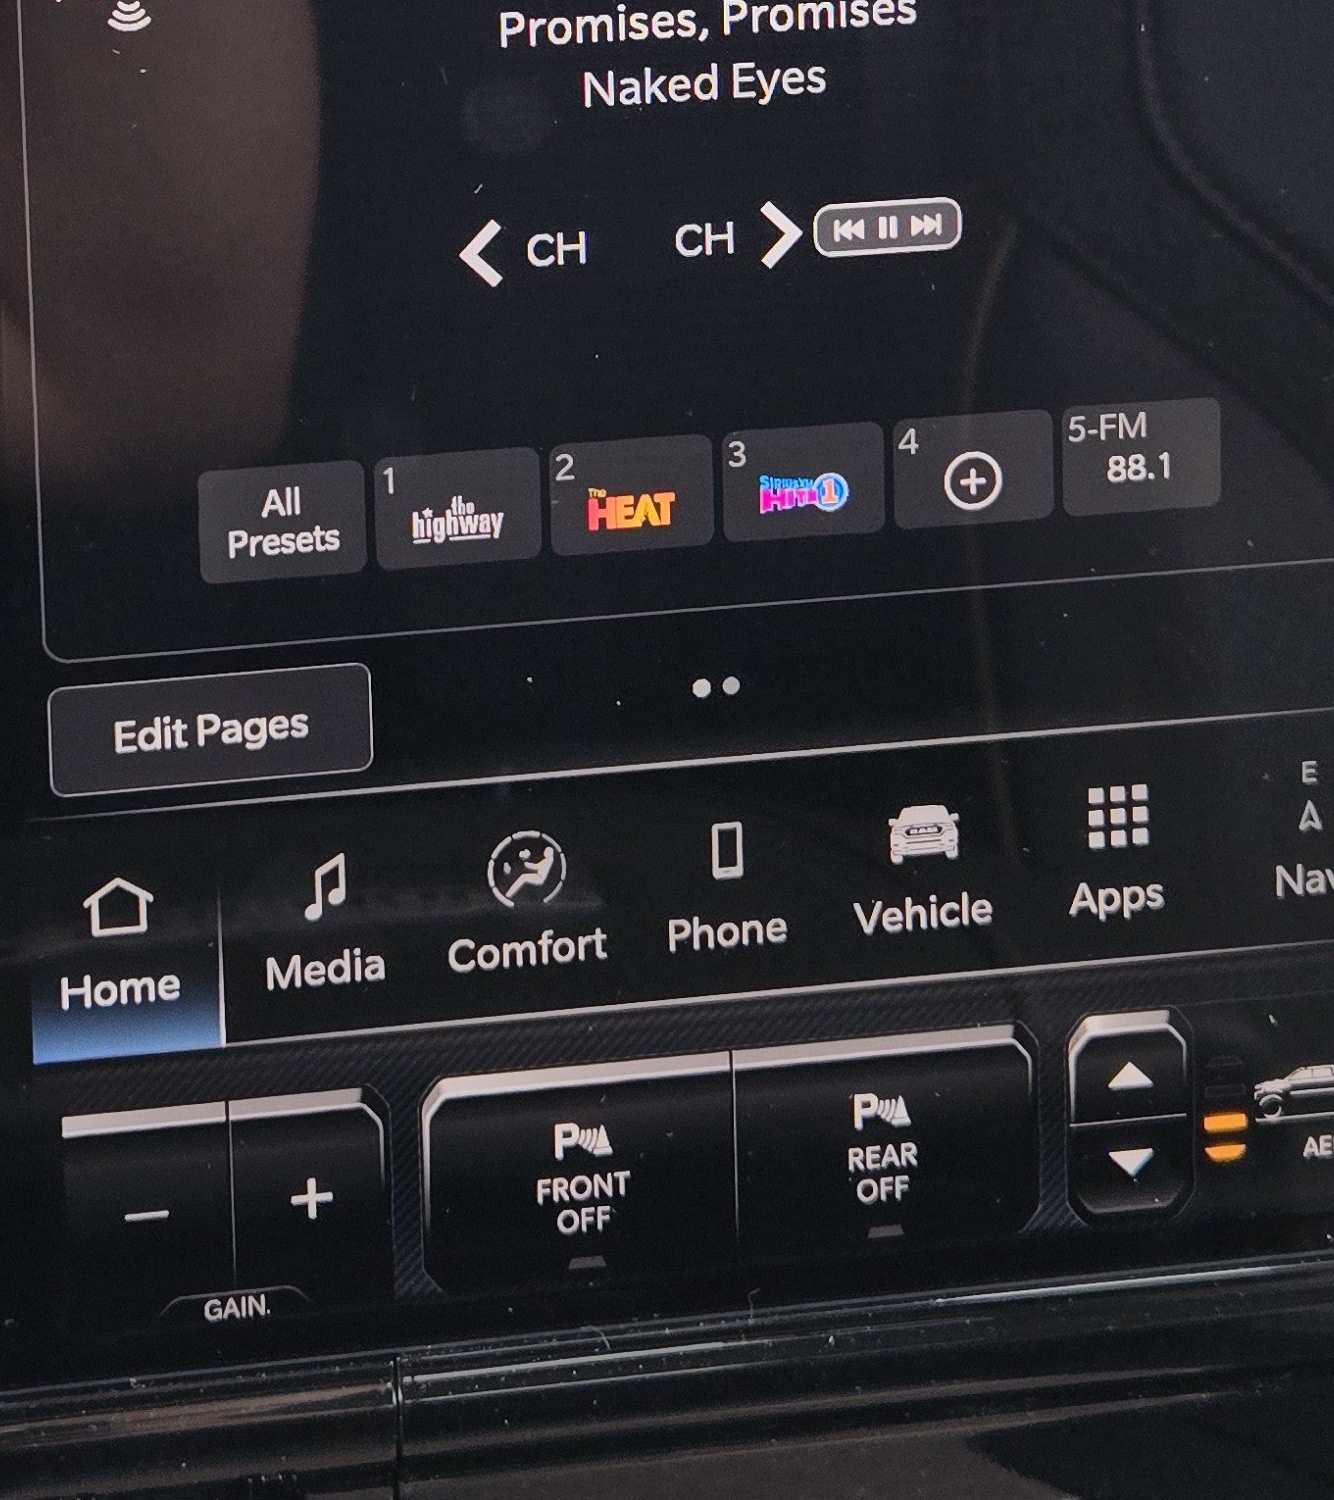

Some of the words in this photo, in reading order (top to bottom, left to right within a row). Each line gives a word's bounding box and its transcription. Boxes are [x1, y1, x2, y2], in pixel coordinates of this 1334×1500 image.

[500, 4, 710, 48] Promises,
[583, 63, 719, 108] Naked
[732, 61, 828, 104] Eyes
[526, 231, 587, 267] CH
[675, 221, 735, 257] CH
[898, 428, 919, 455] 4
[1068, 412, 1148, 442] 5-FM
[555, 453, 575, 481] 2
[728, 440, 747, 468] 3
[1107, 452, 1172, 483] 88.1
[383, 467, 395, 495] 1
[261, 486, 301, 518] All
[587, 492, 676, 531] HEAT
[228, 525, 341, 559] Presets
[412, 508, 505, 543] highway
[113, 717, 188, 754] Edit
[196, 710, 309, 751] Pages
[1302, 760, 1318, 783] E
[853, 891, 994, 937] Vehicle
[1069, 880, 1165, 921] Apps
[447, 927, 608, 973] Comfort
[668, 913, 788, 953] Phone
[265, 947, 387, 991] Media
[59, 974, 182, 1011] Home
[847, 1141, 919, 1172] REAR
[536, 1170, 631, 1204] FRONT
[856, 1174, 911, 1204] OFF
[556, 1204, 611, 1235] OFF
[203, 1292, 267, 1322] GAIN
